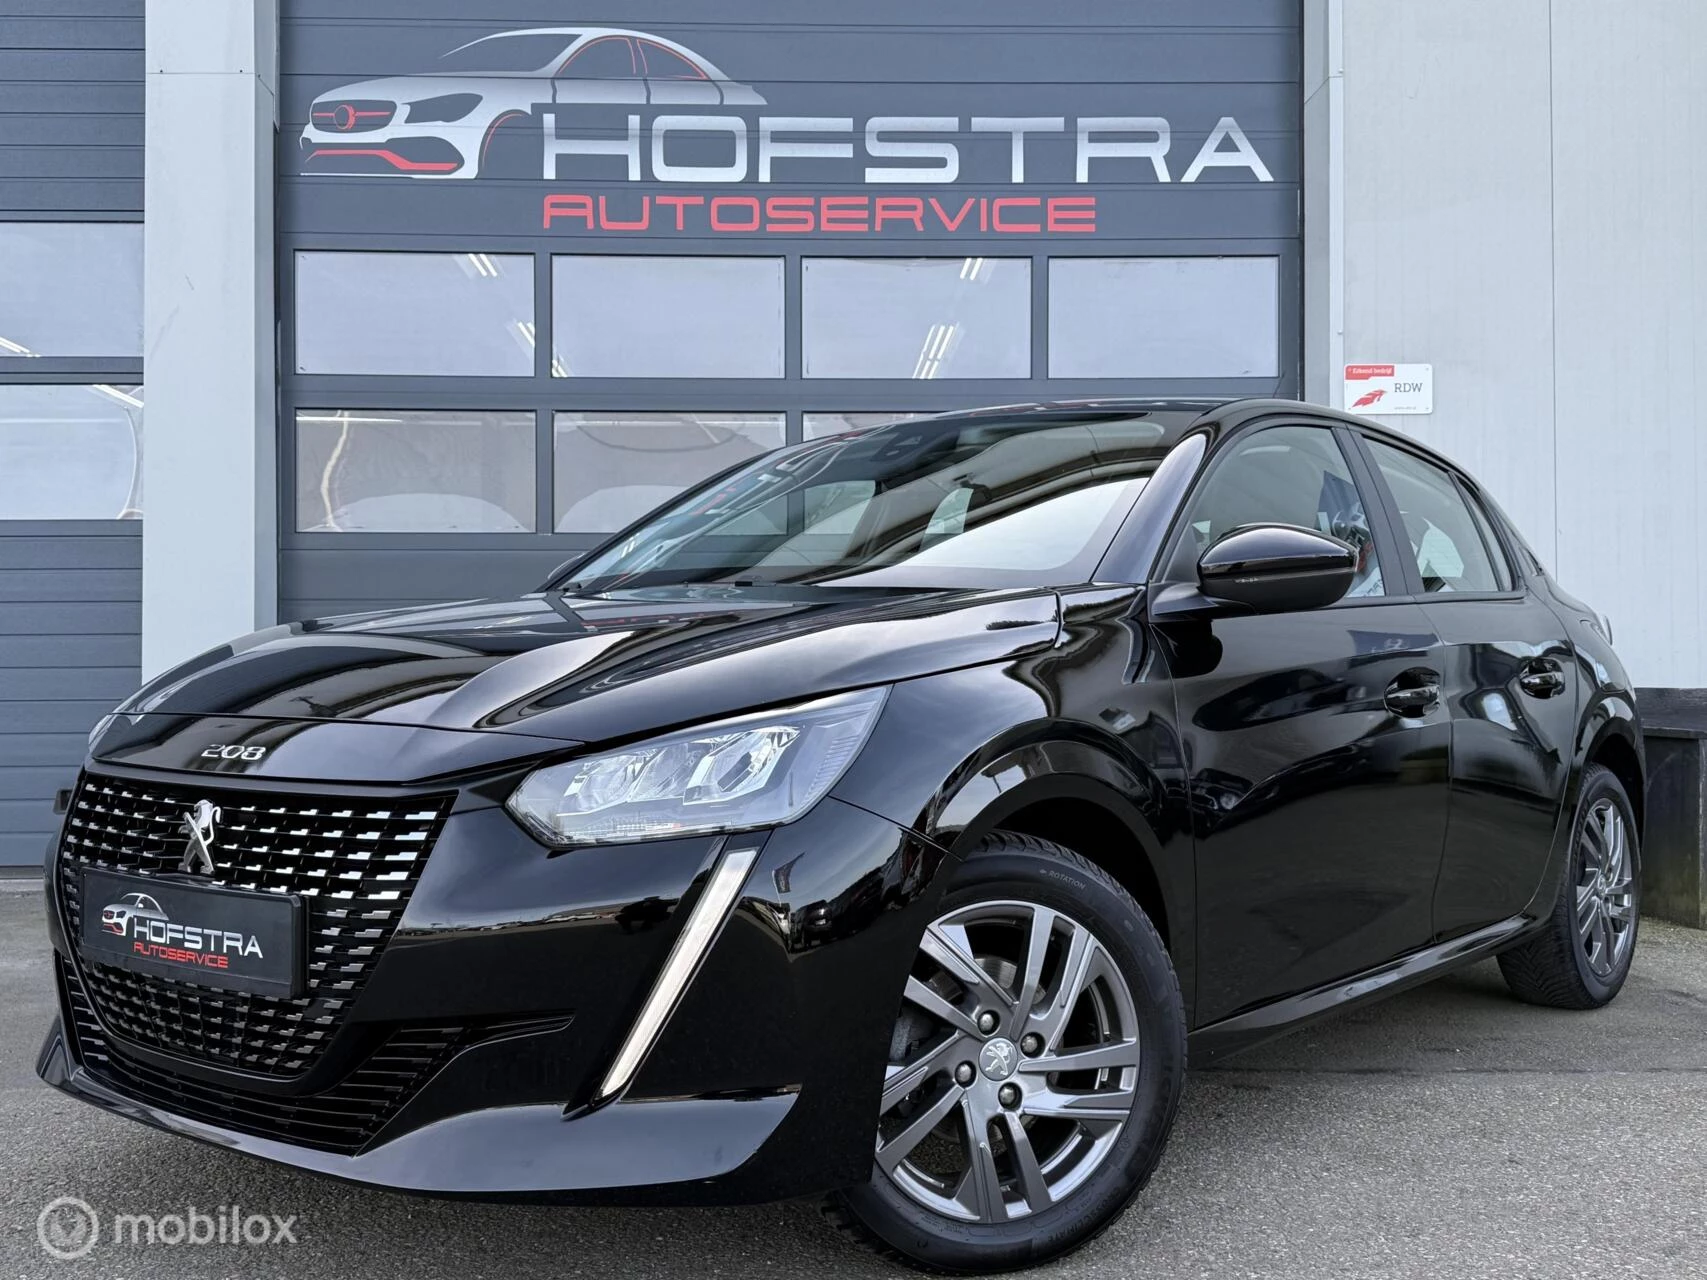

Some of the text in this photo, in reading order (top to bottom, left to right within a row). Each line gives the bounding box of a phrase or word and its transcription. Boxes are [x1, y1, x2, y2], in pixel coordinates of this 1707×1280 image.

[542, 113, 1275, 183] HOFSTRA
[543, 194, 1096, 233] AUTOSERVICE
[1394, 382, 1423, 393] RDW
[201, 744, 267, 760] 208
[1048, 869, 1087, 891] ROTATION
[133, 917, 264, 959] HOFSTRA
[133, 942, 229, 968] AUTOSERVICE
